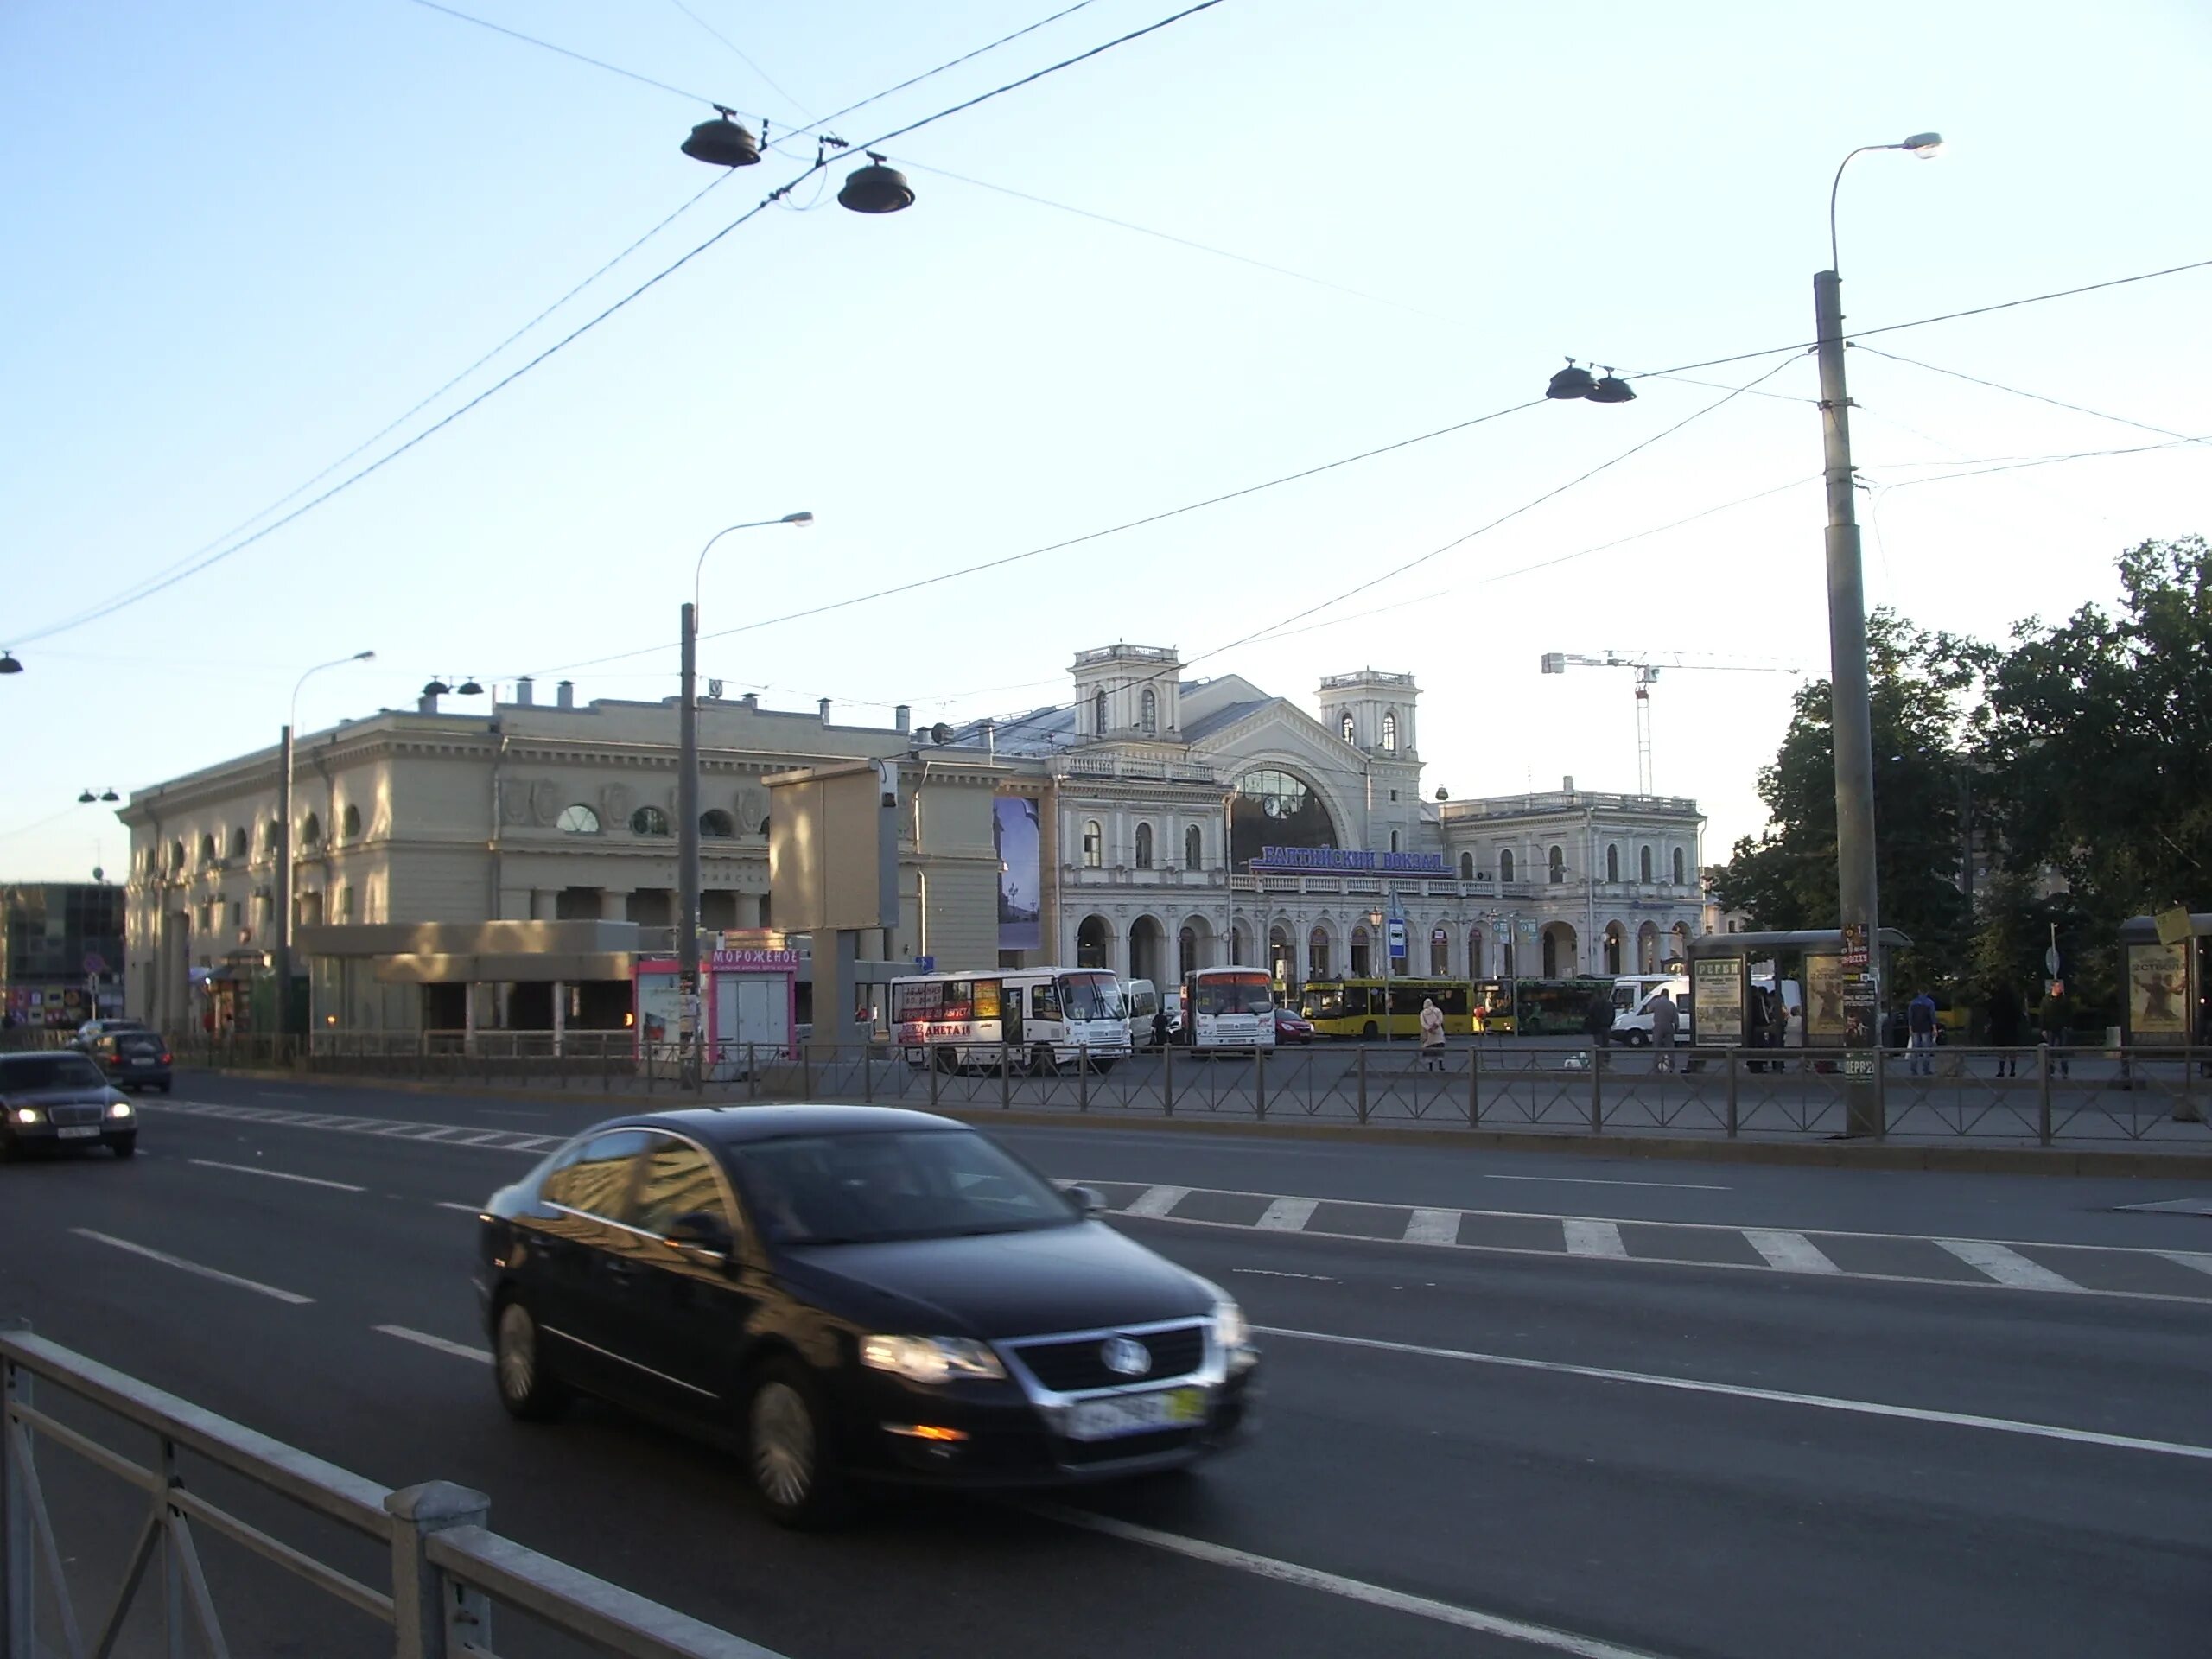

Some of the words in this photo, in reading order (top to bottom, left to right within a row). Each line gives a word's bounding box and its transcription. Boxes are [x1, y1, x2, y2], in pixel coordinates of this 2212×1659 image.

[1262, 844, 1375, 868] БАЛТИЙСКИЙ
[1382, 851, 1441, 870] ВОКЗАЛ
[713, 950, 798, 963] МОРОЖЕНОЕ
